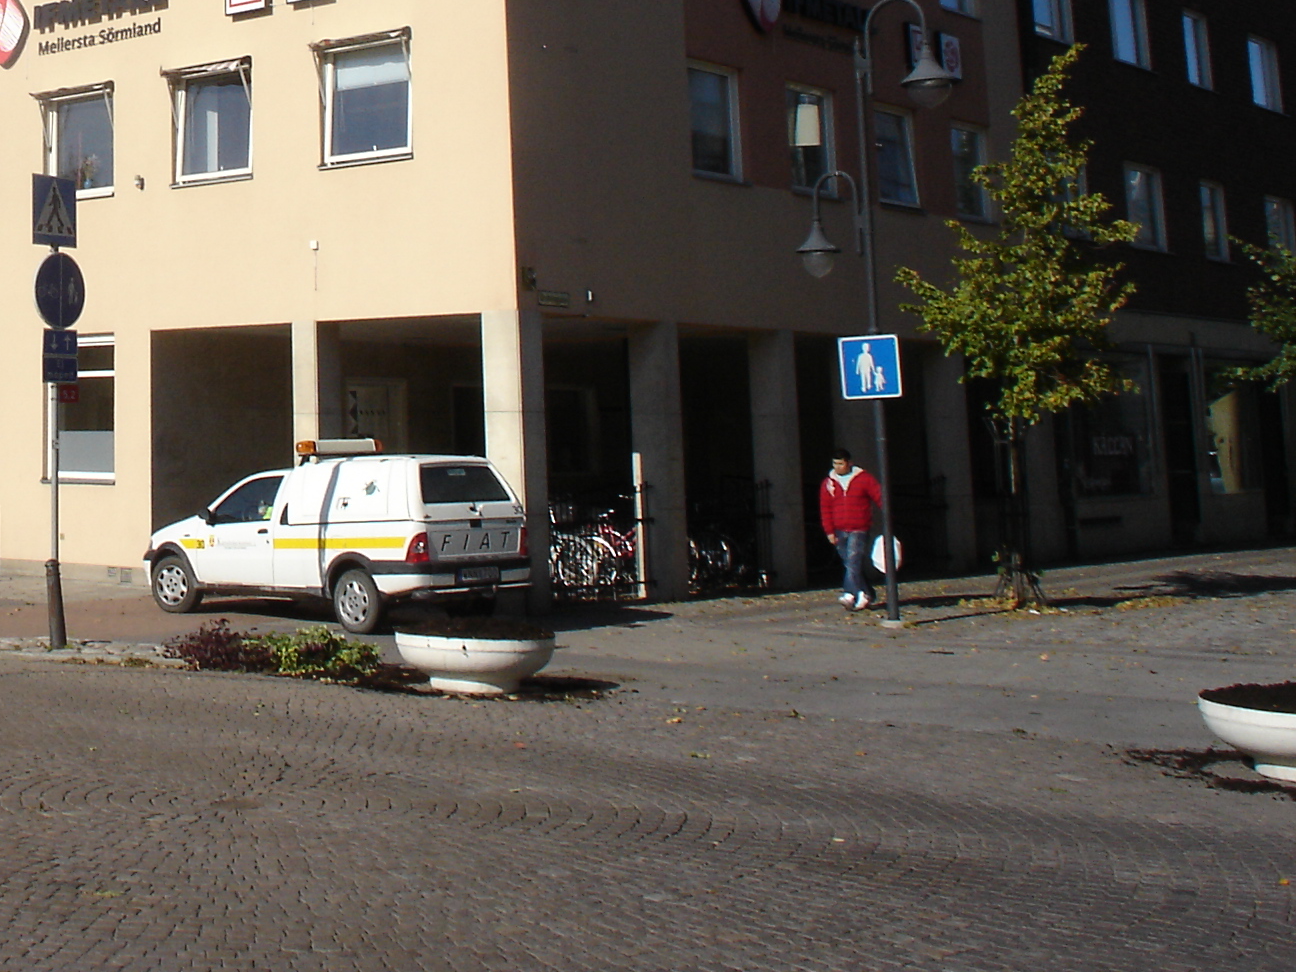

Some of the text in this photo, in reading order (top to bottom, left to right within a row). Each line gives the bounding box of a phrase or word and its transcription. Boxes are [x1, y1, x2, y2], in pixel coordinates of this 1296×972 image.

[38, 17, 162, 56] Mellersta Sörmland
[441, 531, 510, 552] FIAT
